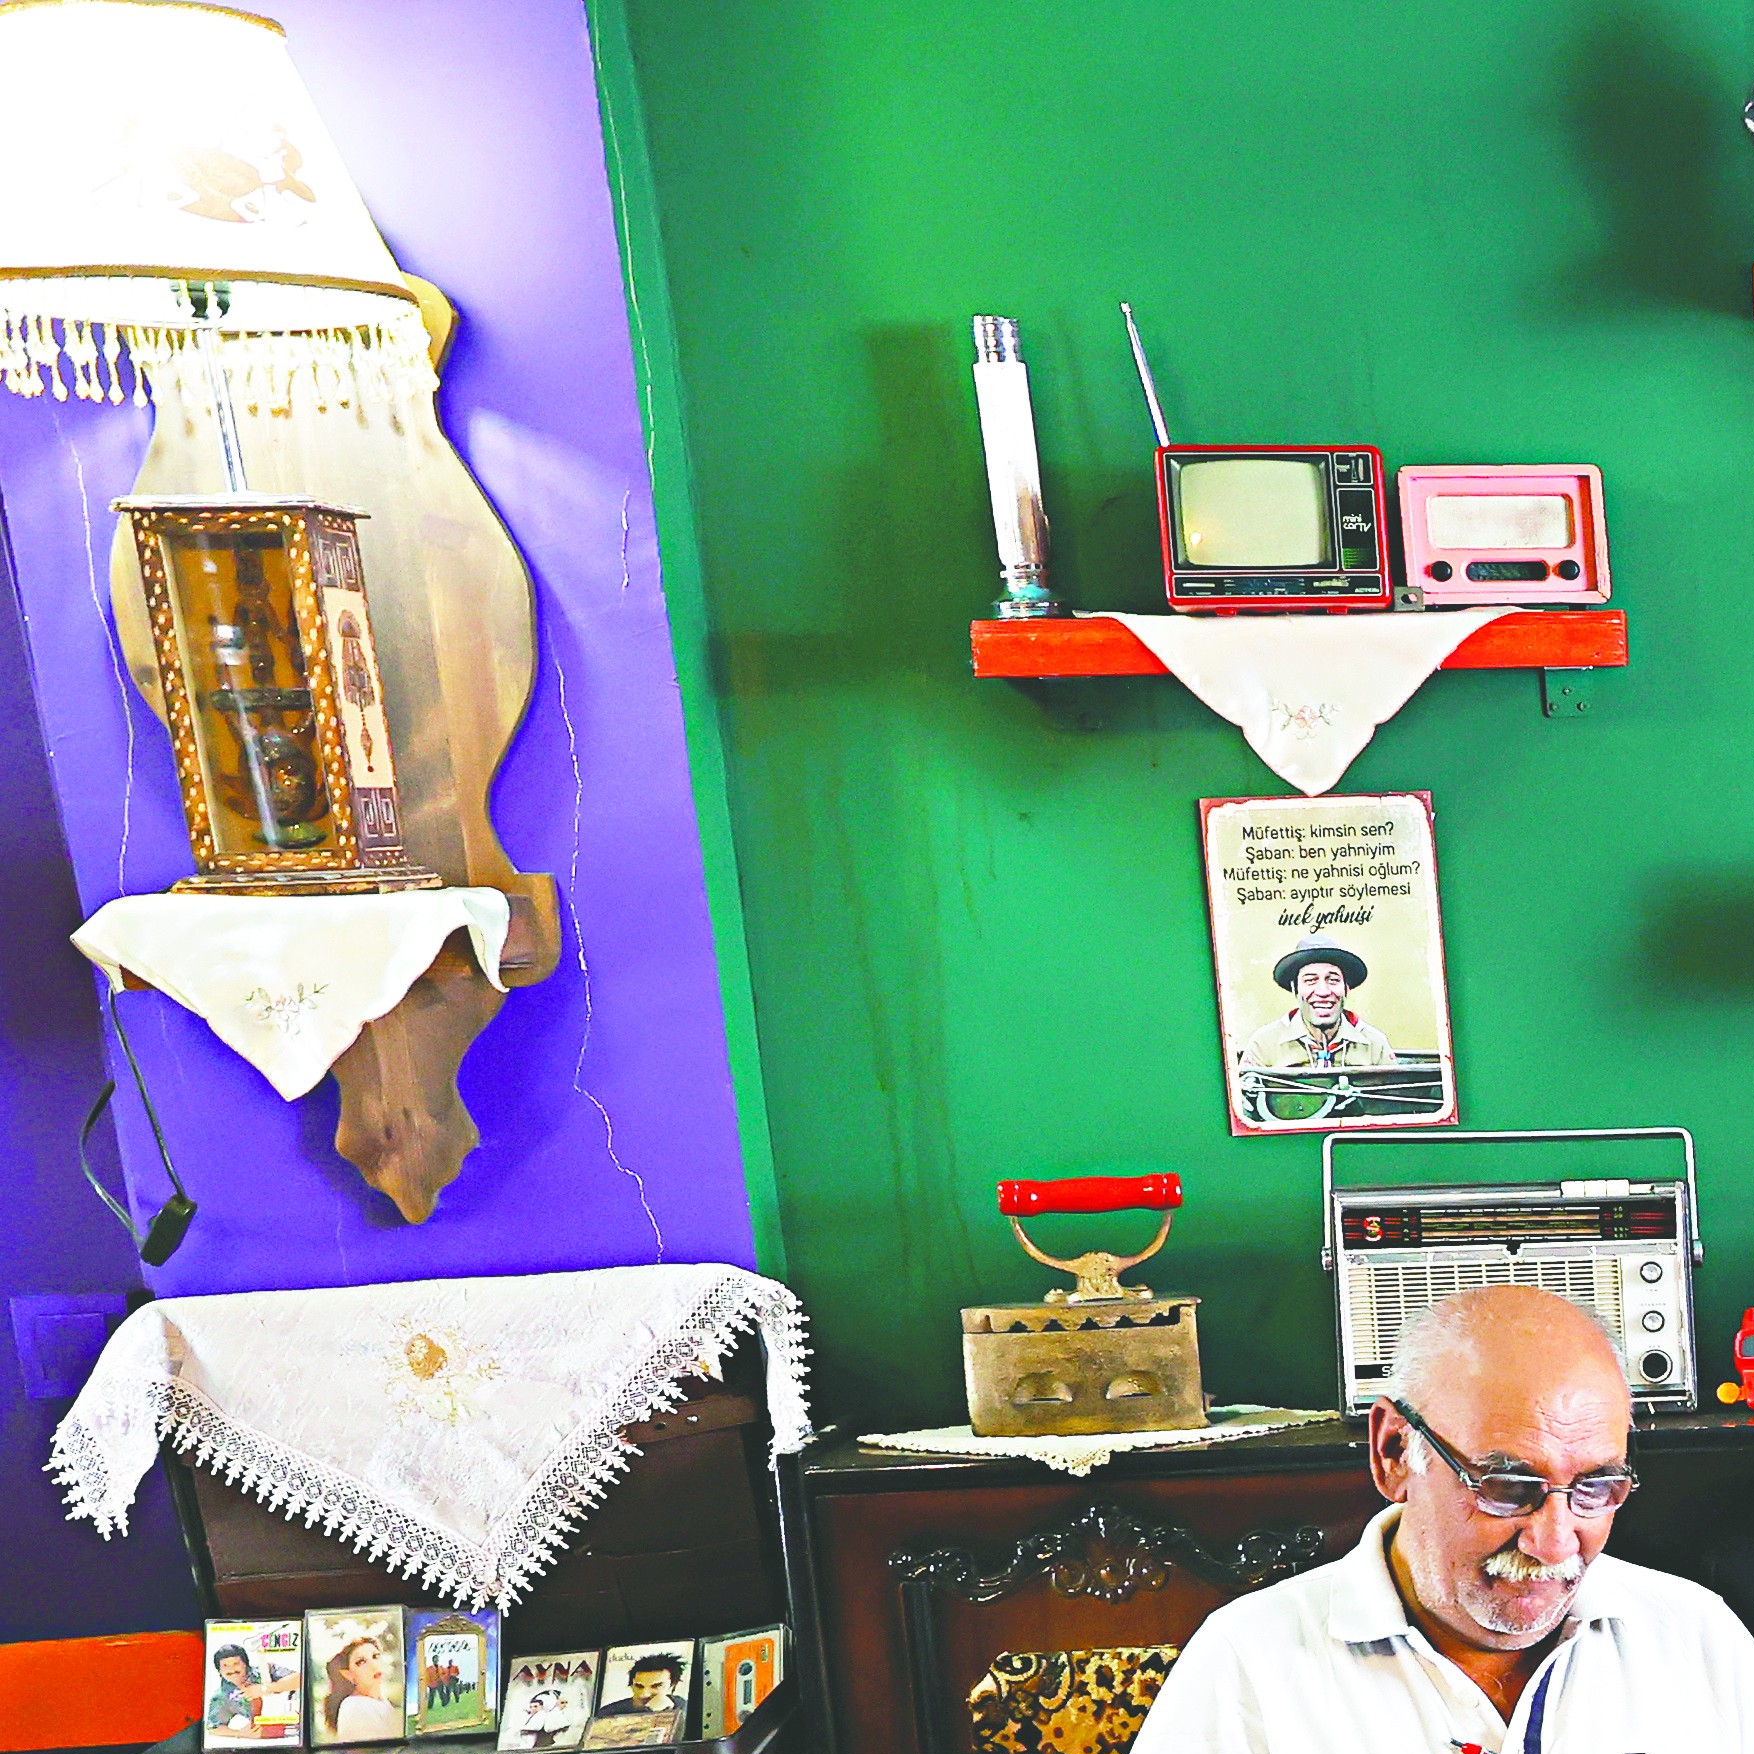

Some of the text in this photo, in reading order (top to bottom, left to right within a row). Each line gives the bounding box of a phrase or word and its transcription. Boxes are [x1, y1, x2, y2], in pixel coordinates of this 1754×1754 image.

[1342, 513, 1362, 523] mini
[1242, 821, 1394, 842] Müfettiş: kimsin sen?
[1245, 843, 1395, 864] Şaban: ben yahniyim
[1223, 861, 1421, 883] Müfettiş: ne yahnisi oğlum?
[1237, 882, 1411, 905] Şaban: ayıptır söylemesi
[1278, 902, 1316, 926] inek
[512, 1659, 593, 1684] AYNA
